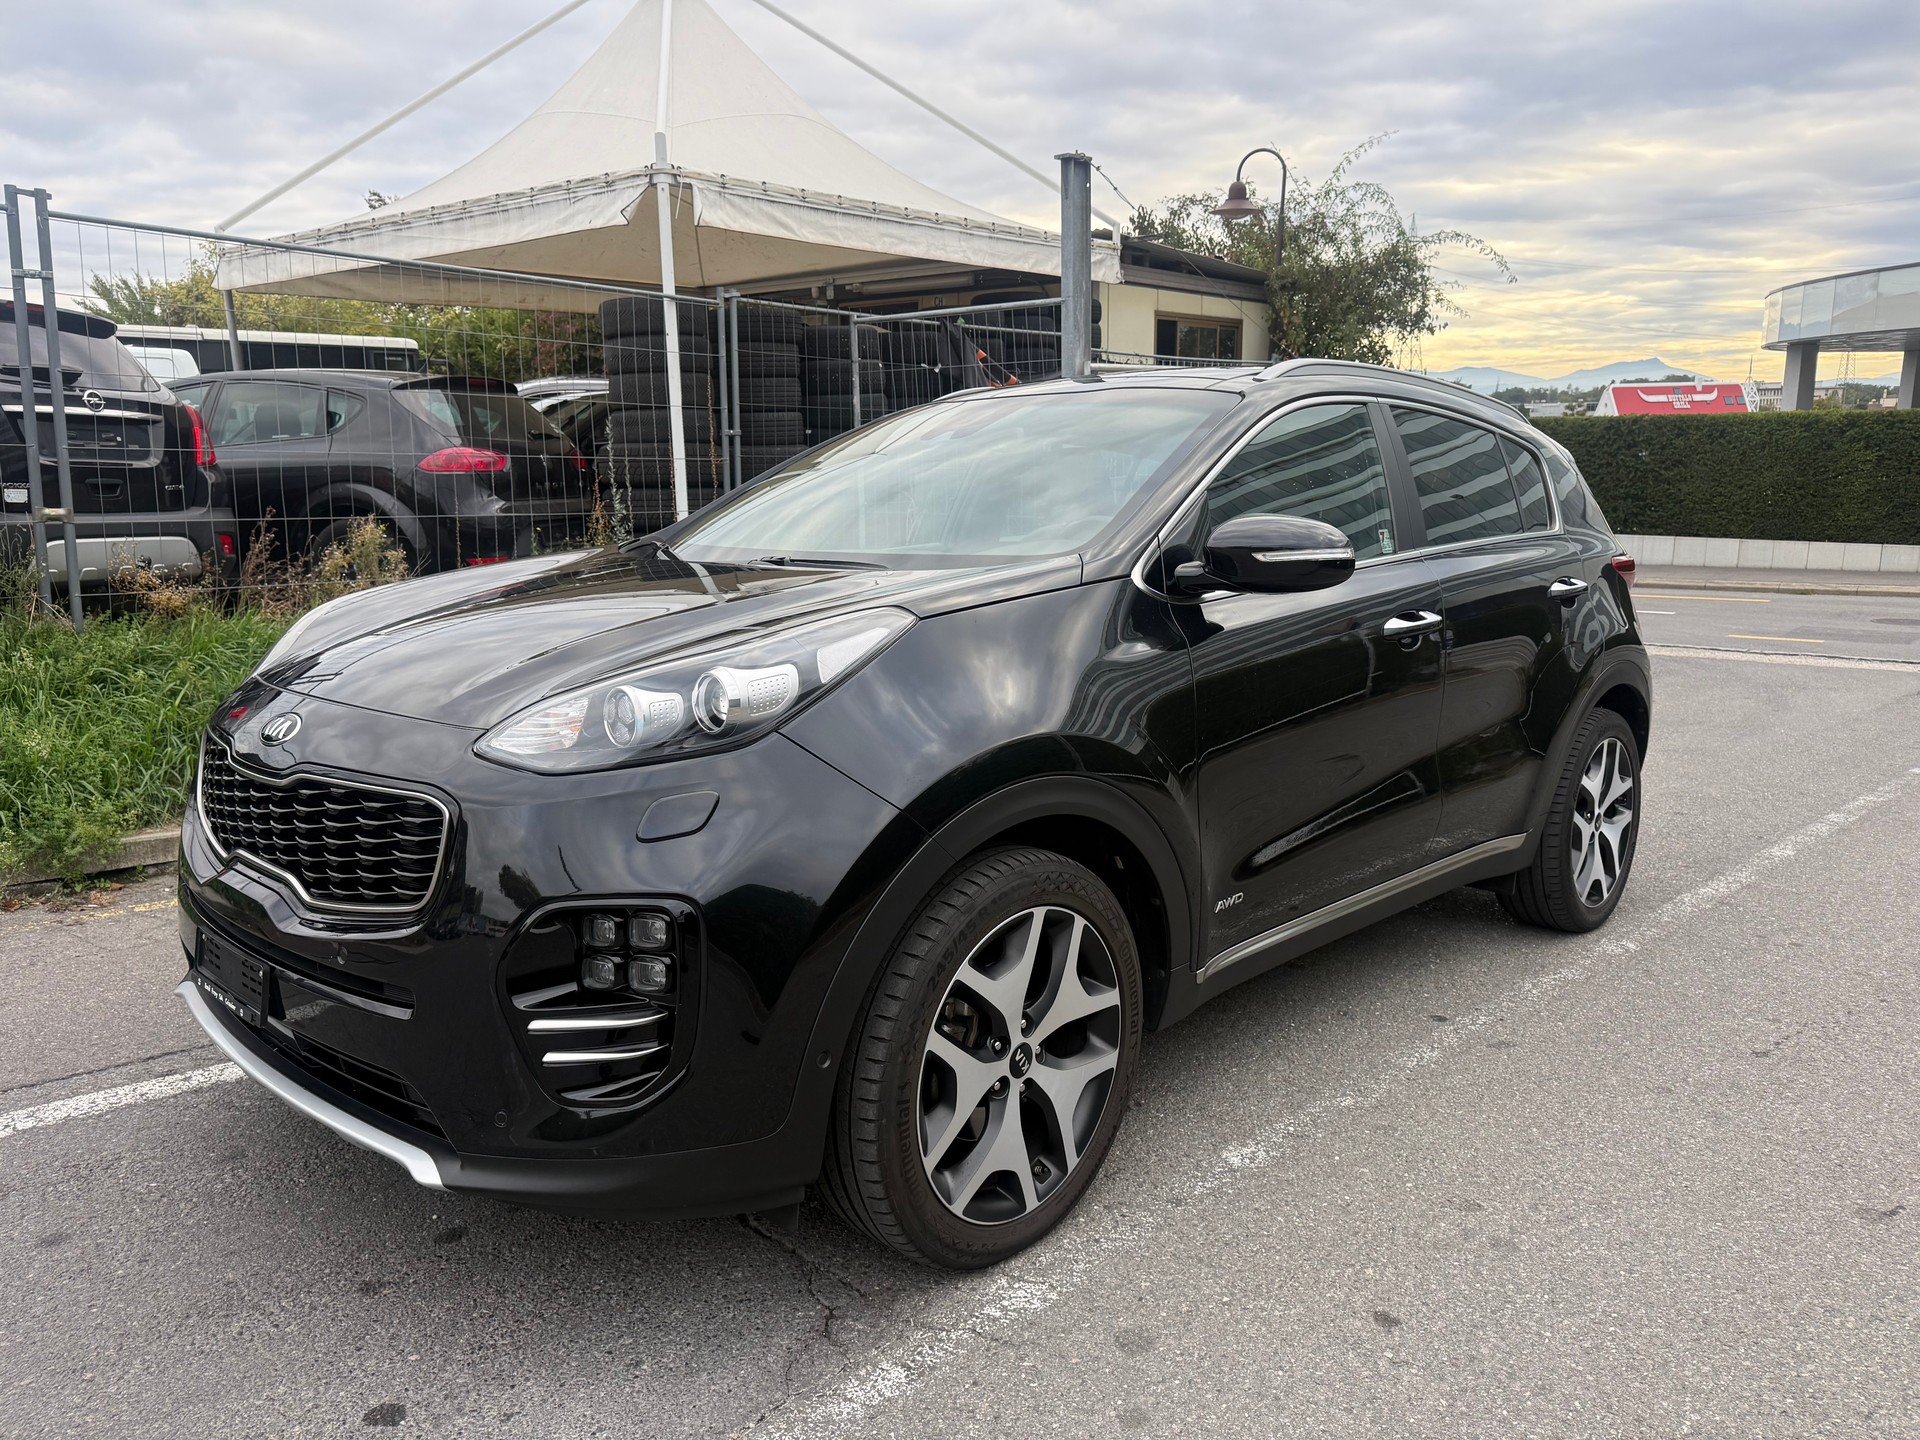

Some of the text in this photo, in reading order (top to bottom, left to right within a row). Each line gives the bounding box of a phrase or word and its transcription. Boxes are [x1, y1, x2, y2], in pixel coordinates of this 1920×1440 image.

[1214, 892, 1244, 913] AWD
[927, 918, 977, 992] 245/45
[1015, 1048, 1030, 1074] KIA
